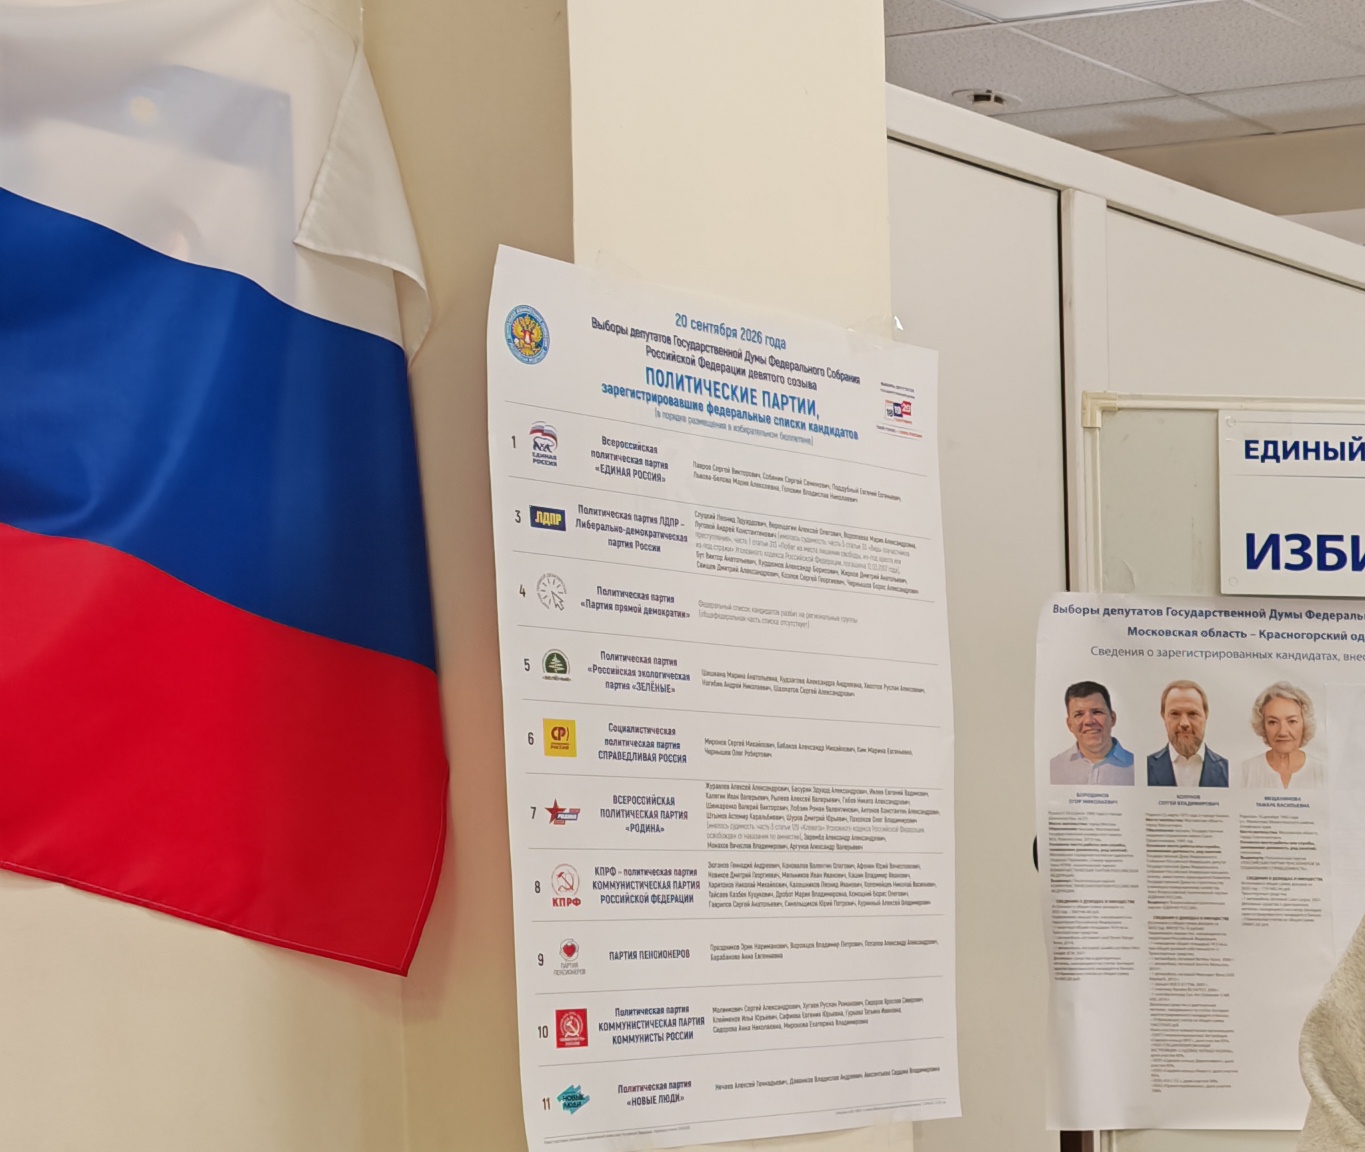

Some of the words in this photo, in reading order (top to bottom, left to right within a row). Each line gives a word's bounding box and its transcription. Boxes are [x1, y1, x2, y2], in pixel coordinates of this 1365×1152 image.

[675, 313, 687, 327] 20
[691, 319, 737, 339] сентября
[741, 327, 762, 344] 2026
[765, 335, 786, 349] года
[592, 317, 628, 335] Выборы
[630, 328, 671, 344] депутатов
[674, 335, 742, 359] Государственной
[744, 351, 766, 364] Думы
[769, 355, 825, 376] Федерального
[827, 368, 860, 384] Собрания
[646, 345, 695, 366] Российской
[698, 357, 746, 376] Федерации
[748, 370, 784, 384] девятого
[787, 378, 817, 390] созыва
[646, 367, 757, 405] ПОЛИТИЧЕСКИЕ
[763, 390, 819, 419] ПАРТИИ,
[602, 383, 703, 412] зарегистрировавшие
[707, 401, 770, 424] федеральные
[774, 418, 806, 430] списки
[809, 423, 858, 440] кандидатов
[512, 435, 516, 448] 1
[602, 436, 658, 454] Всероссийская
[591, 450, 643, 465] политическая
[645, 459, 668, 470] партия
[595, 464, 631, 478] «ЕДИНАЯ
[633, 470, 666, 482] РОССИЯ»
[515, 510, 521, 523] 3
[535, 511, 561, 526] ЛДПР
[578, 504, 632, 520] Политическая
[634, 514, 657, 524] партия
[659, 516, 679, 527] ЛДПР
[576, 519, 688, 542] Либерально-демократическая
[608, 538, 633, 549] партия
[635, 541, 660, 552] России
[519, 584, 525, 597] 4
[597, 586, 649, 600] Политическая
[651, 594, 674, 604] партия
[581, 599, 613, 611] «Партия
[615, 603, 642, 614] прямой
[643, 606, 690, 618] демократии»
[1053, 604, 1099, 617] Выборы
[1103, 608, 1163, 618] депутатов
[1166, 607, 1266, 619] Государственной
[1269, 609, 1302, 621] Думы
[1128, 626, 1198, 637] Московская
[1201, 628, 1247, 639] область
[1259, 630, 1347, 642] Красногорский
[601, 651, 651, 664] Политическая
[653, 657, 677, 667] партия
[1091, 646, 1144, 657] Сведения
[1147, 649, 1154, 657] о
[1157, 650, 1273, 660] зарегистрированных
[1276, 652, 1341, 663] кандидатах,
[524, 658, 530, 671] 5
[588, 664, 636, 677] «Российская
[638, 670, 690, 681] экологическая
[605, 681, 630, 691] партия
[632, 681, 675, 693] «ЗЕЛЁНЫЕ»
[609, 723, 675, 735] Социалистическая
[528, 732, 534, 745] 6
[605, 739, 654, 748] политическая
[657, 741, 680, 750] партия
[598, 750, 656, 762] СПРАВЕДЛИВАЯ
[659, 753, 686, 763] РОССИЯ
[613, 794, 675, 805] ВСЕРОССИЙСКАЯ
[531, 807, 536, 819] 7
[600, 809, 658, 819] ПОЛИТИЧЕСКАЯ
[661, 811, 688, 820] ПАРТИЯ
[626, 824, 664, 834] «РОДИНА»
[595, 866, 616, 876] КПРФ
[674, 869, 697, 877] партия
[535, 881, 541, 893] 8
[593, 881, 671, 890] КОММУНИСТИЧЕСКАЯ
[673, 880, 700, 890] ПАРТИЯ
[552, 898, 581, 907] КПРФ
[601, 892, 649, 904] РОССИЙСКОЙ
[651, 894, 694, 904] ФЕДЕРАЦИИ
[538, 953, 544, 966] 9
[609, 950, 637, 960] ПАРТИЯ
[639, 949, 690, 960] ПЕНСИОНЕРОВ
[615, 1007, 664, 1017] Политическая
[666, 1006, 689, 1015] партия
[599, 1018, 676, 1032] КОММУНИСТИЧЕСКАЯ
[679, 1017, 705, 1026] ПАРТИЯ
[538, 1025, 548, 1038] 10
[613, 1032, 664, 1045] КОММУНИСТЫ
[666, 1031, 693, 1041] РОССИИ
[618, 1083, 667, 1094] Политическая
[669, 1080, 692, 1091] партия
[542, 1098, 550, 1110] 11
[627, 1095, 656, 1106] «НОВЫЕ
[658, 1093, 684, 1105] ЛЮДИ»
